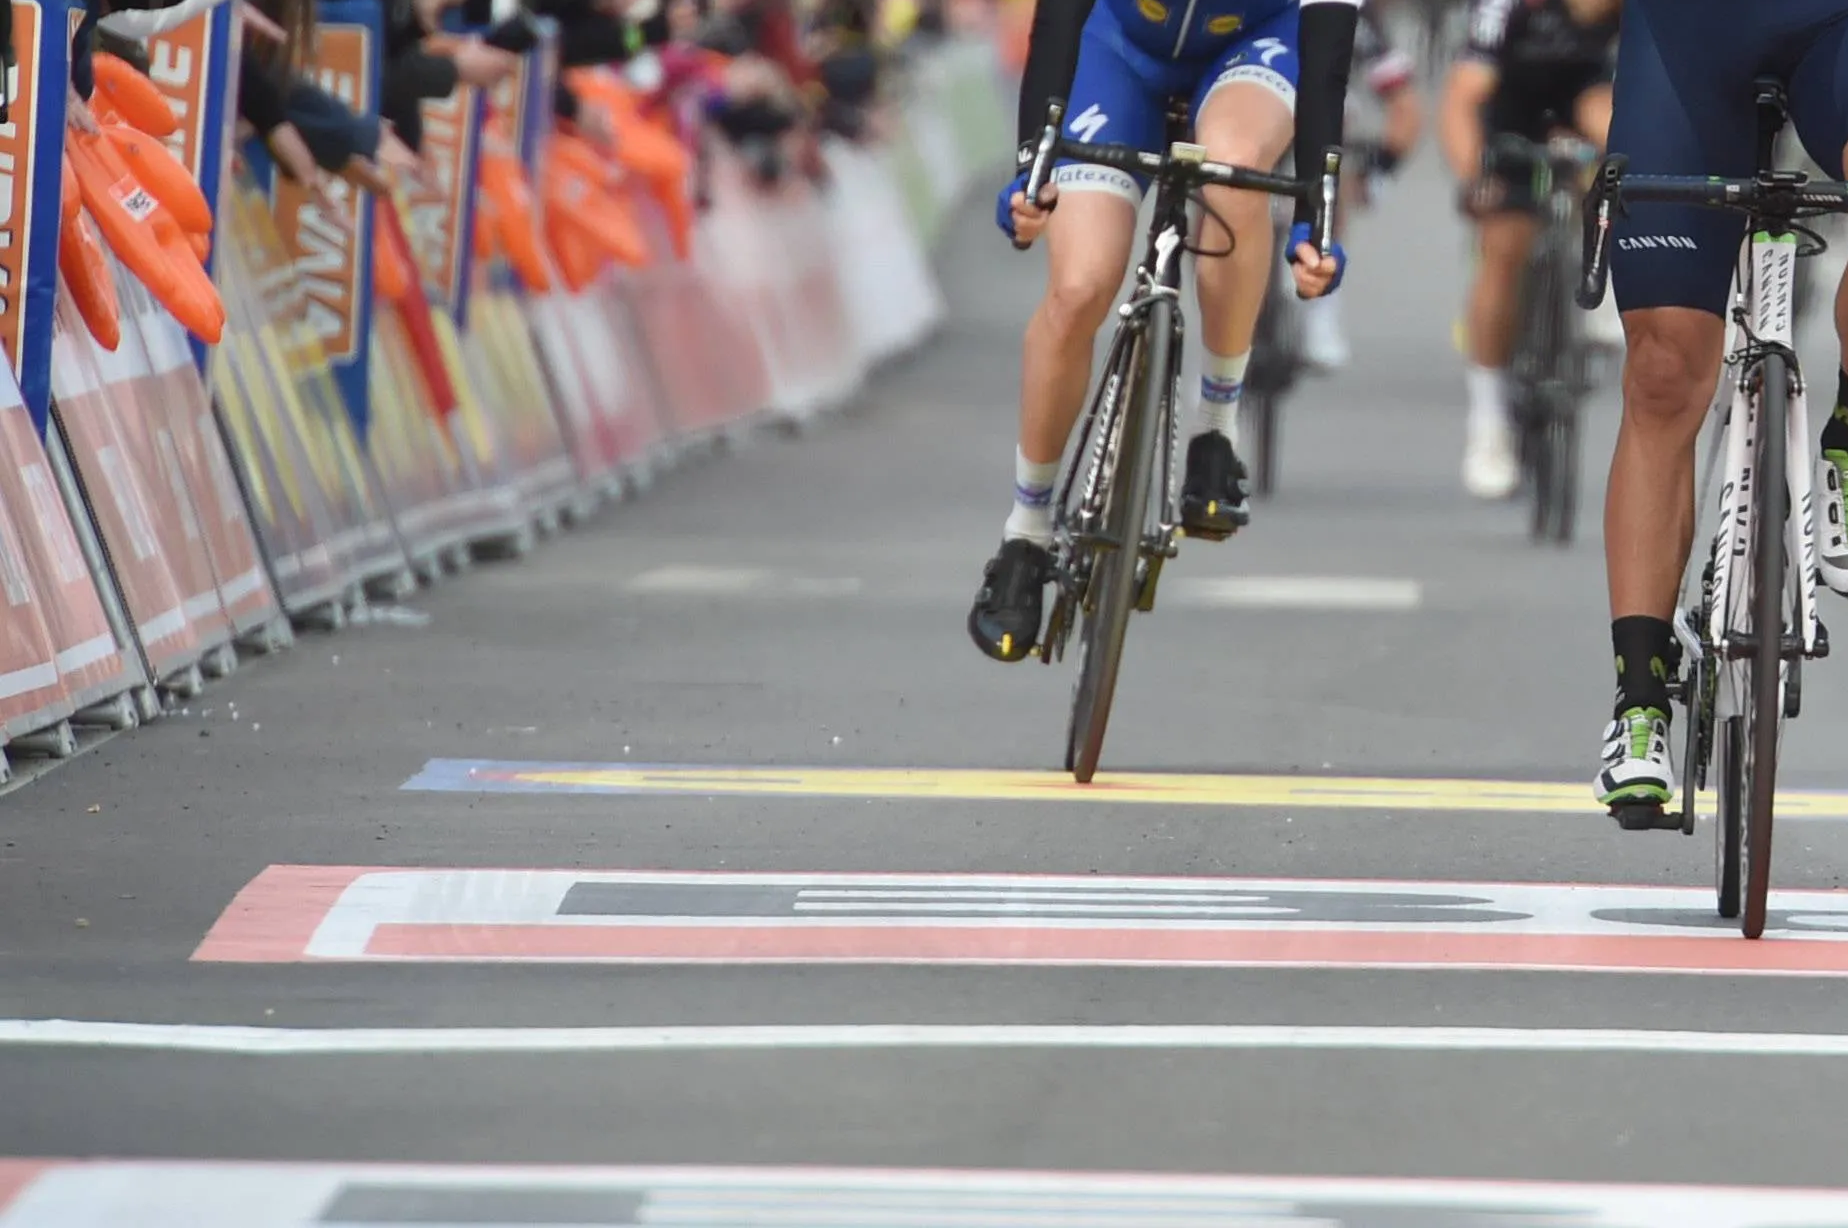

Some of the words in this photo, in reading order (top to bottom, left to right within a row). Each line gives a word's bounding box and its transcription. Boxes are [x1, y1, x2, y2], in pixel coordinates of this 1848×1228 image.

[1618, 234, 1698, 251] CANYON
[1760, 248, 1775, 332] CANYON
[1776, 252, 1790, 332] CANYON
